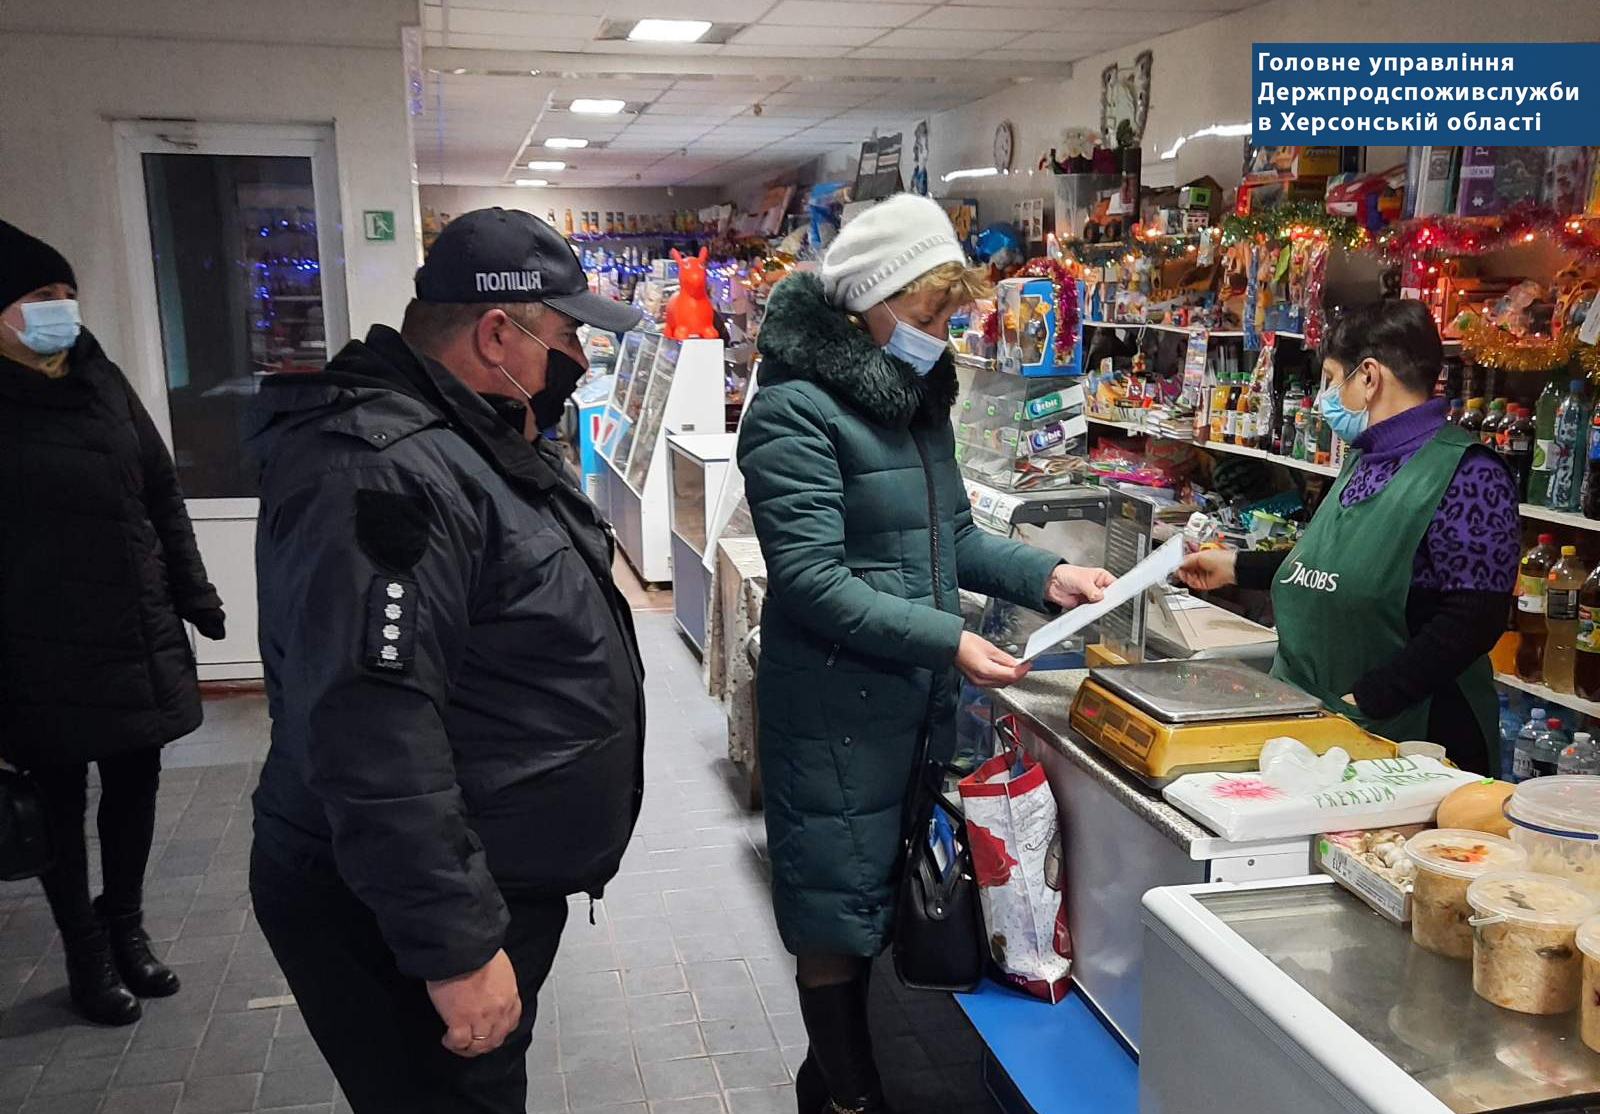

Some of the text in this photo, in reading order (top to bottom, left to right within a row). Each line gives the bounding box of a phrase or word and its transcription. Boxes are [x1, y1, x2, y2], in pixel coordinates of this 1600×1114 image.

[475, 271, 542, 292] ПОЛІЦІЯ
[1279, 561, 1339, 592] JACOBS
[1313, 785, 1396, 808] PREMIUM
